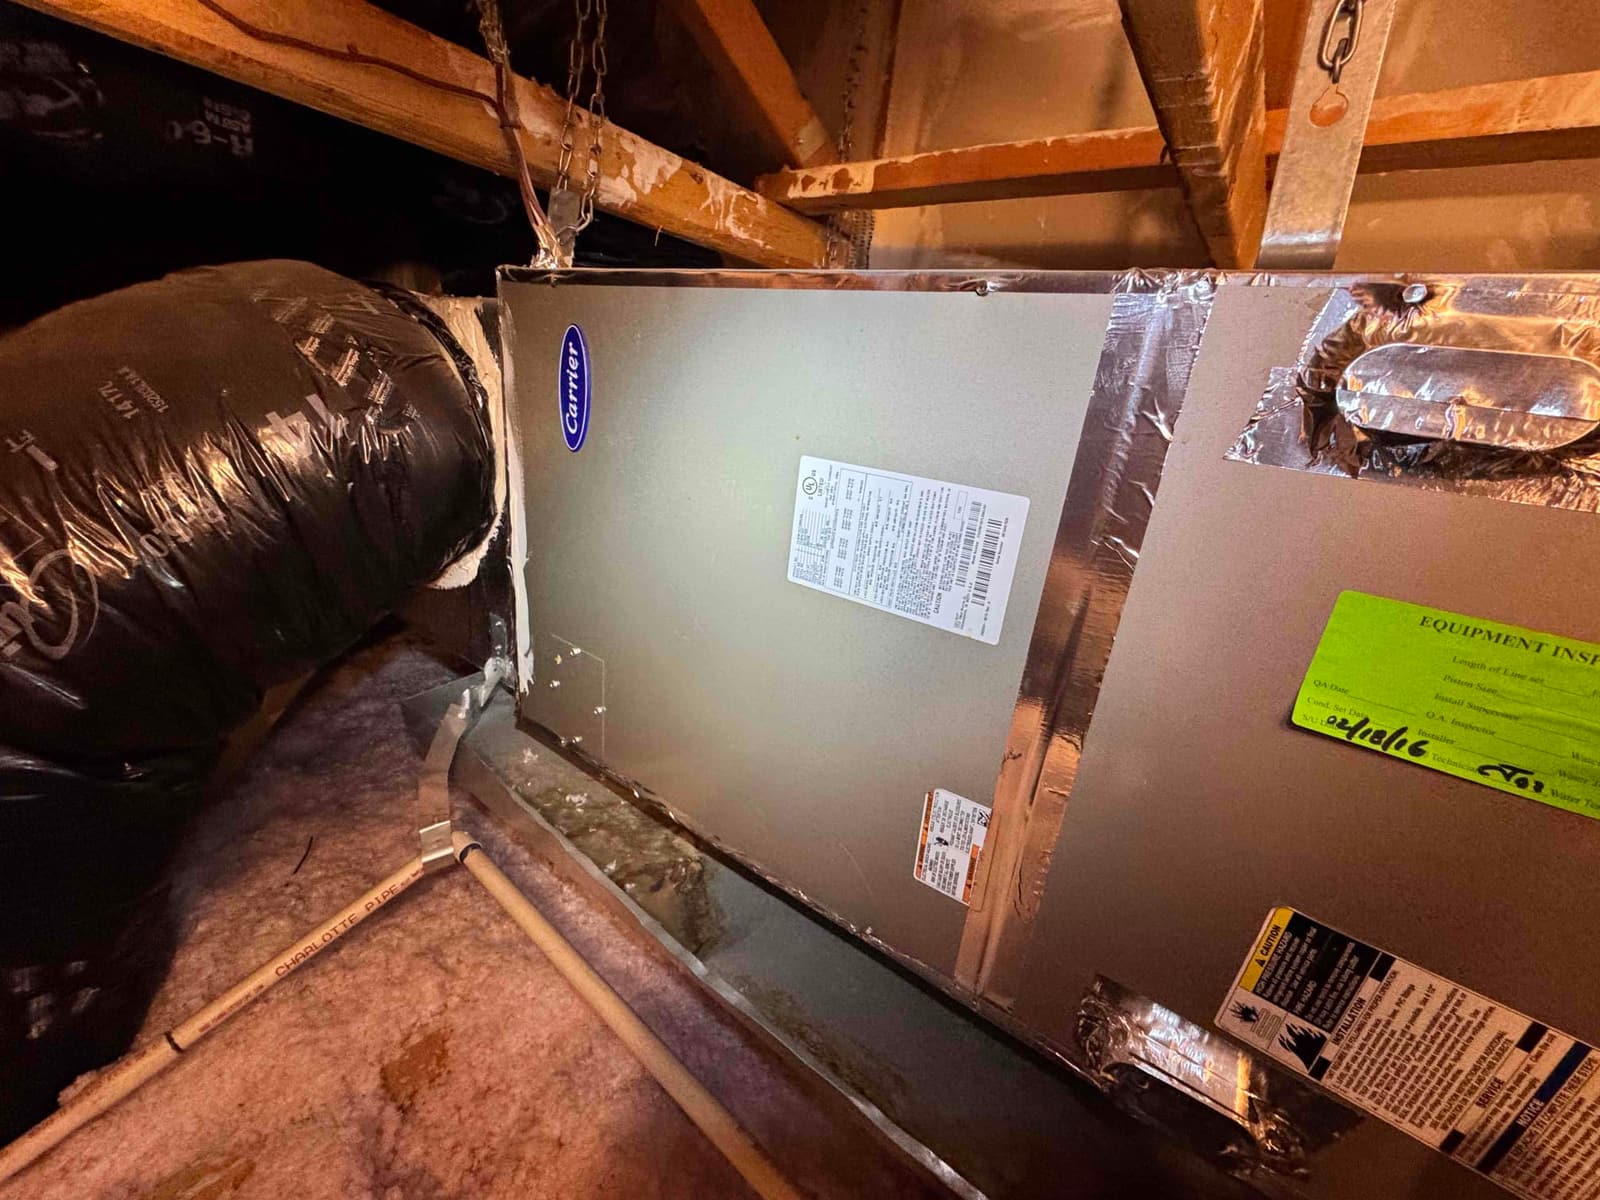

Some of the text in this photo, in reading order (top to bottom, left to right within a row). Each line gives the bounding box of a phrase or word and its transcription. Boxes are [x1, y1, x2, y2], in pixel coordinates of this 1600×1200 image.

[566, 341, 579, 434] Carrier
[933, 592, 942, 613] CAUTION
[1419, 615, 1549, 654] EQUIPMENT
[1452, 655, 1488, 673] Length
[1488, 663, 1502, 675] of
[1503, 666, 1528, 680] Line
[1329, 684, 1350, 695] Date
[1443, 673, 1499, 696] Piston Size
[1333, 704, 1347, 714] Set
[1434, 693, 1520, 721] Install Supervisor
[1326, 715, 1430, 757] 02/18/16
[1417, 728, 1456, 746] Installer
[1451, 718, 1496, 736] Inspector
[1551, 787, 1581, 804] Water
[274, 883, 400, 978] CHARLOTTE PIPE
[1261, 924, 1281, 956] CAUTION
[1262, 953, 1280, 980] PRESSURE
[1276, 931, 1292, 953] HAZARD
[1293, 979, 1316, 1014] FIRE HAZARD
[1395, 996, 1406, 1007] PVC
[1400, 983, 1415, 998] fittings
[1333, 998, 1366, 1045] INSTALLATION
[1348, 1020, 1366, 1043] FOLLOWING
[1361, 1010, 1372, 1021] FOR
[1367, 994, 1382, 1012] PROPER
[1378, 970, 1397, 995] OPERATION
[1435, 1093, 1459, 1120] INSTALLATION
[1455, 1064, 1481, 1093] INSTRUCTIONS
[1483, 1030, 1506, 1056] ADDITIONAL
[1542, 1057, 1598, 1121] COMPLETE THESE STEPS
[1440, 1104, 1463, 1130] INFORMATION
[1463, 1084, 1479, 1098] THESE
[1480, 1060, 1496, 1076] OTHER
[1476, 1077, 1503, 1108] SERVICE
[1516, 1098, 1544, 1127] NOTICE
